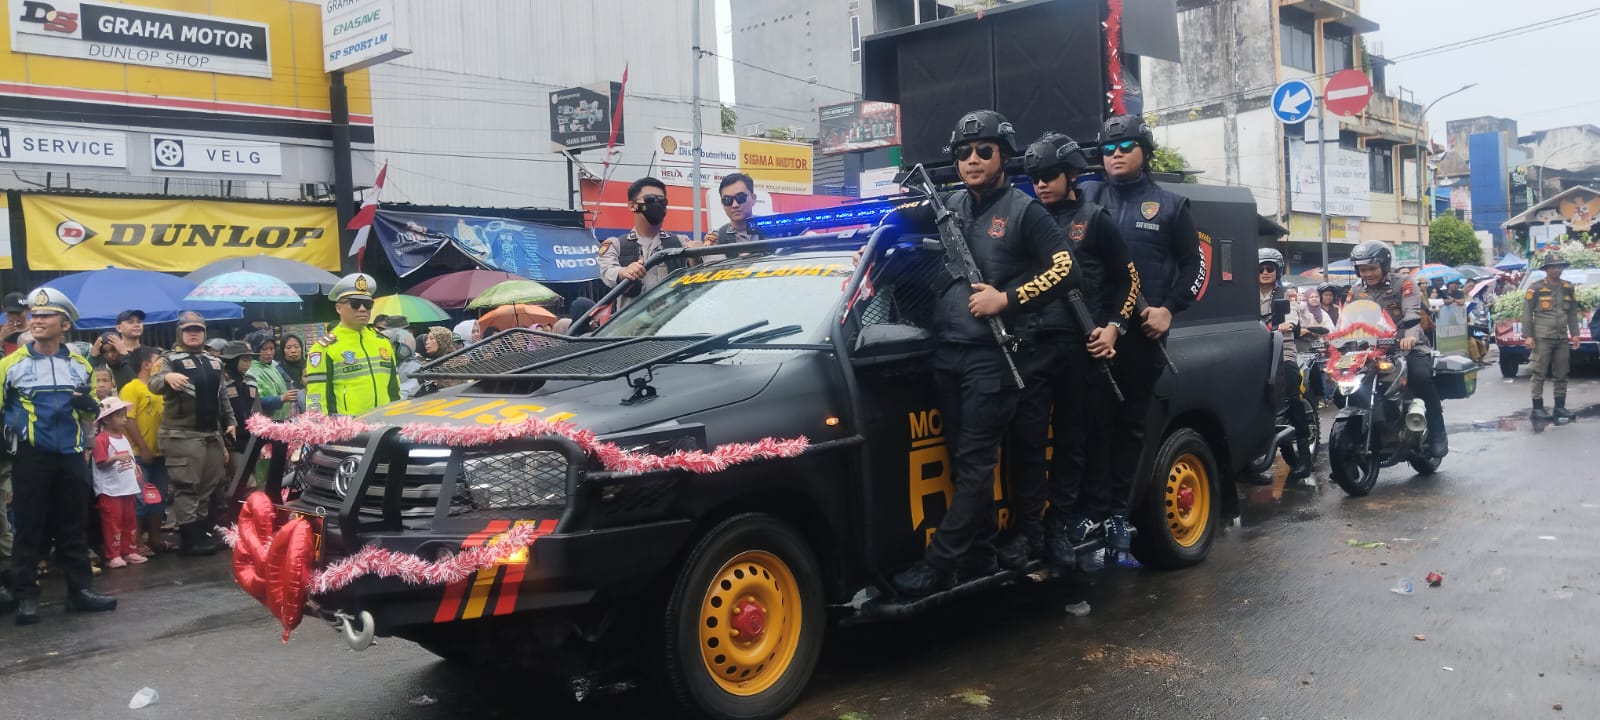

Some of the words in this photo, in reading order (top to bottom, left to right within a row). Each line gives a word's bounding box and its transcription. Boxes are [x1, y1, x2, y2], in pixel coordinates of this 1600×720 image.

[98, 16, 174, 41] GRAHA
[180, 25, 253, 50] MOTOR
[333, 9, 381, 36] ENASAVE
[89, 44, 160, 62] DUNLOP
[165, 51, 209, 68] SHOP
[329, 50, 341, 61] SP
[343, 38, 374, 57] SPORT
[375, 33, 388, 46] LM
[22, 136, 115, 156] SERVICE
[206, 148, 260, 164] VELG
[743, 153, 774, 167] SIGMA
[775, 156, 808, 170] MOTOR
[104, 223, 324, 249] DUNLOP
[553, 245, 600, 256] GRAHA
[556, 257, 600, 269] MOTO
[670, 267, 752, 288] POLRES
[1016, 250, 1072, 304] RESERSE
